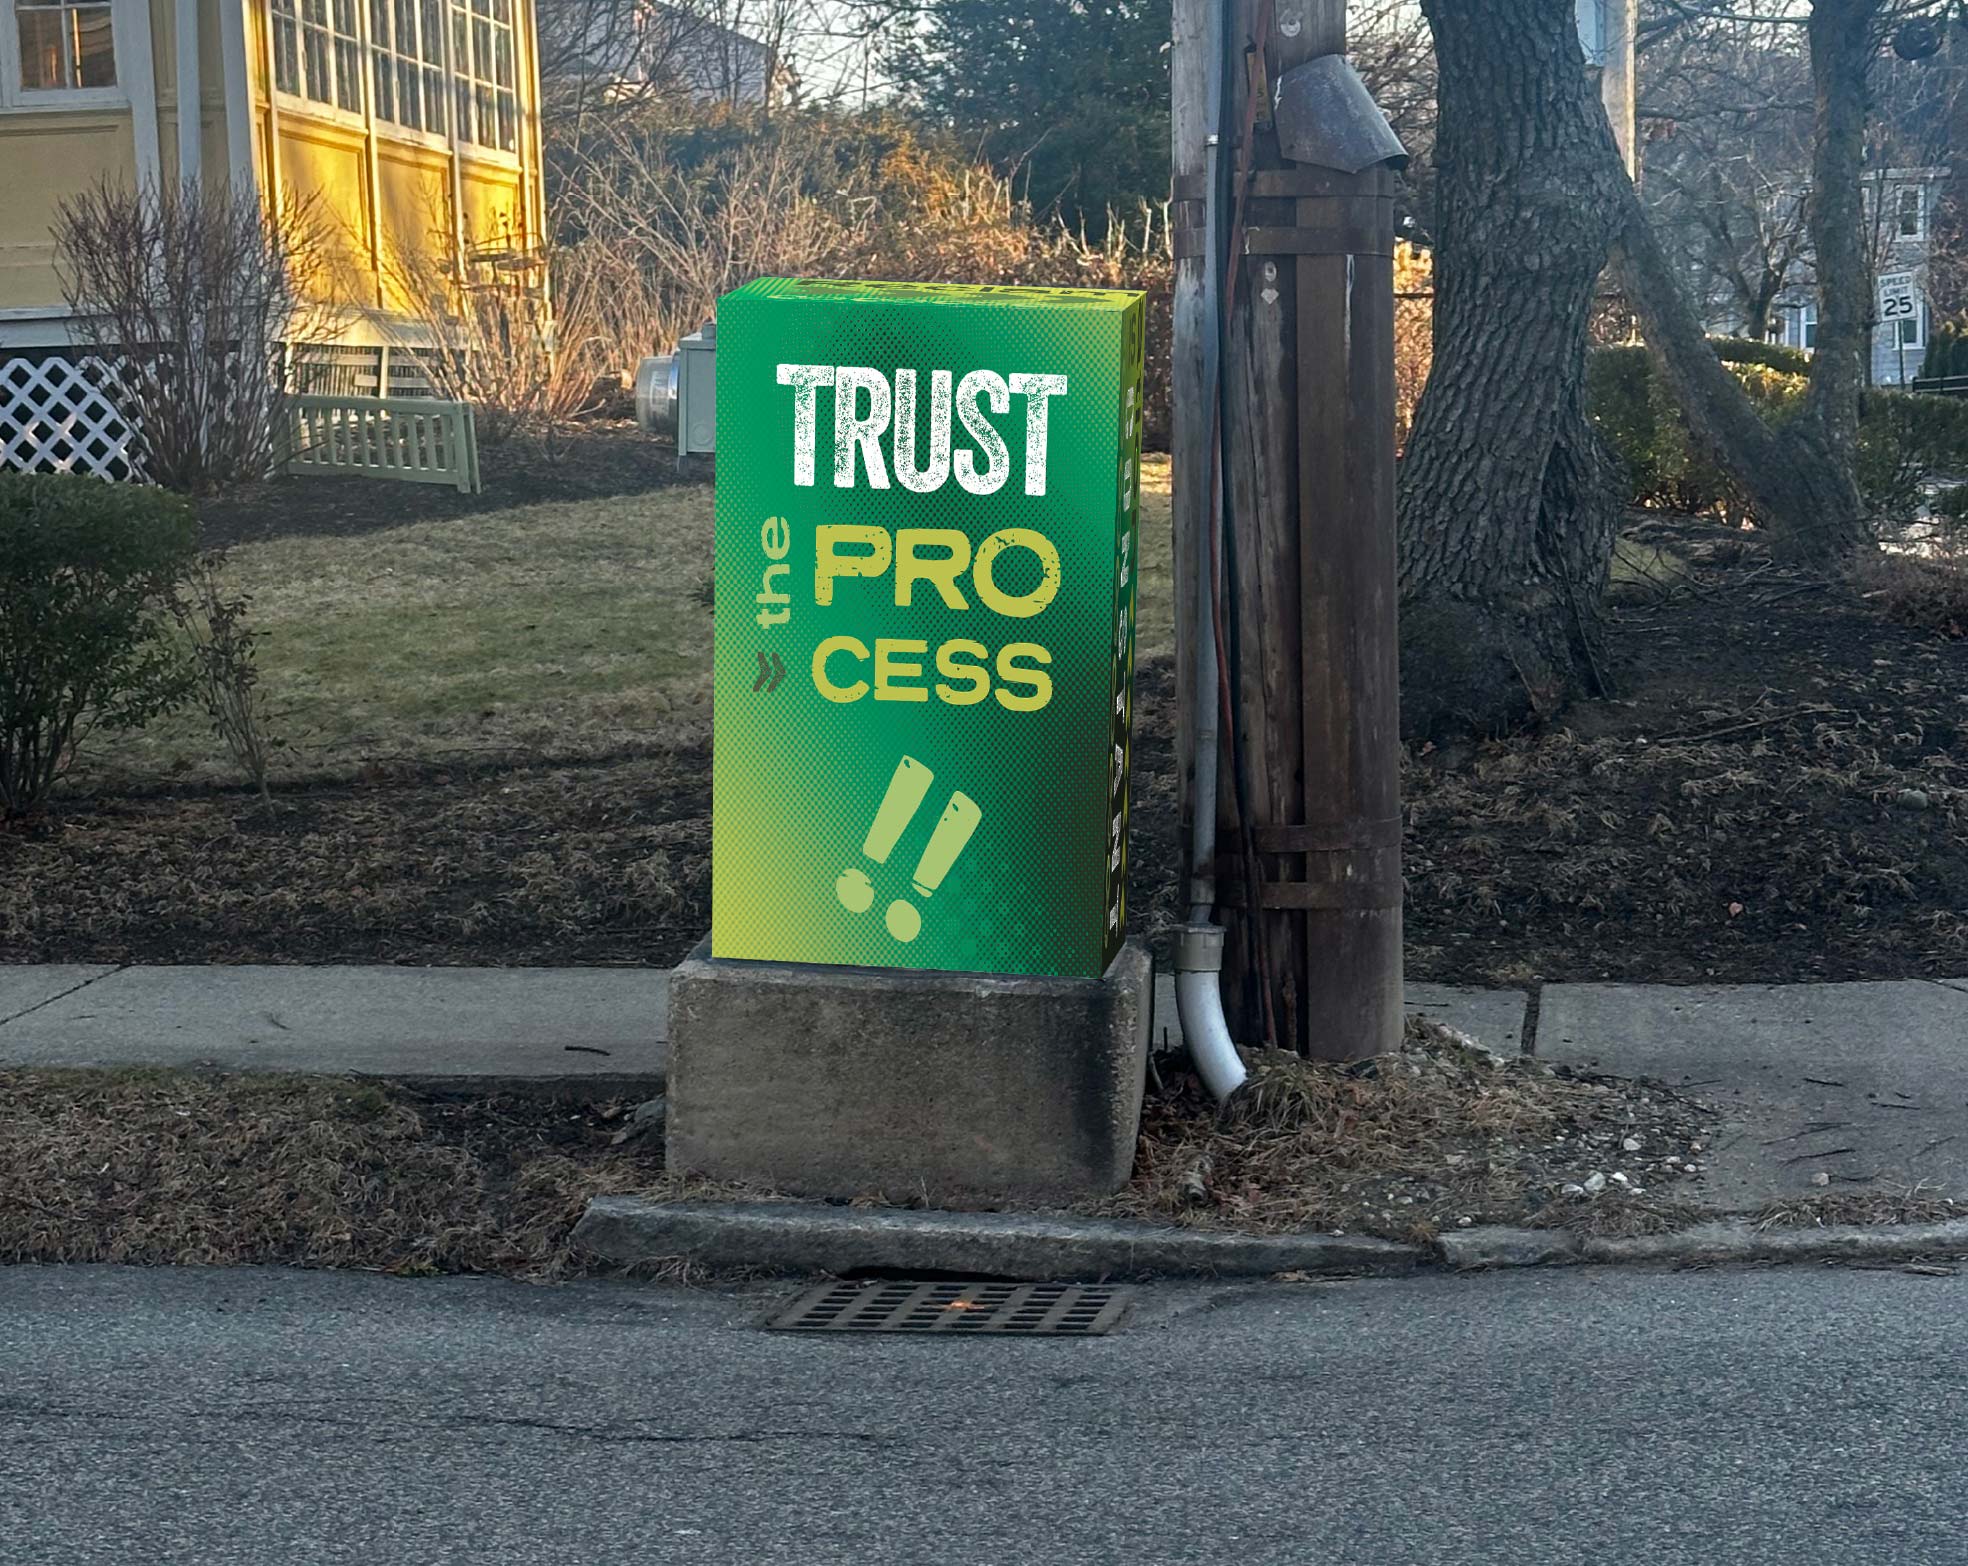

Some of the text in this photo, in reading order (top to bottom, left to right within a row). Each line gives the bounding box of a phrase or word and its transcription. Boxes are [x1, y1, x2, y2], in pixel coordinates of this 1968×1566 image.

[1880, 276, 1912, 287] SPEED
[1882, 296, 1914, 317] 25
[1883, 286, 1909, 297] LIMIT
[776, 363, 1068, 496] TRUST
[756, 516, 791, 629] the
[814, 524, 1061, 618] PRO
[811, 635, 1053, 712] CESS
[1109, 386, 1135, 937] CONSTANT
